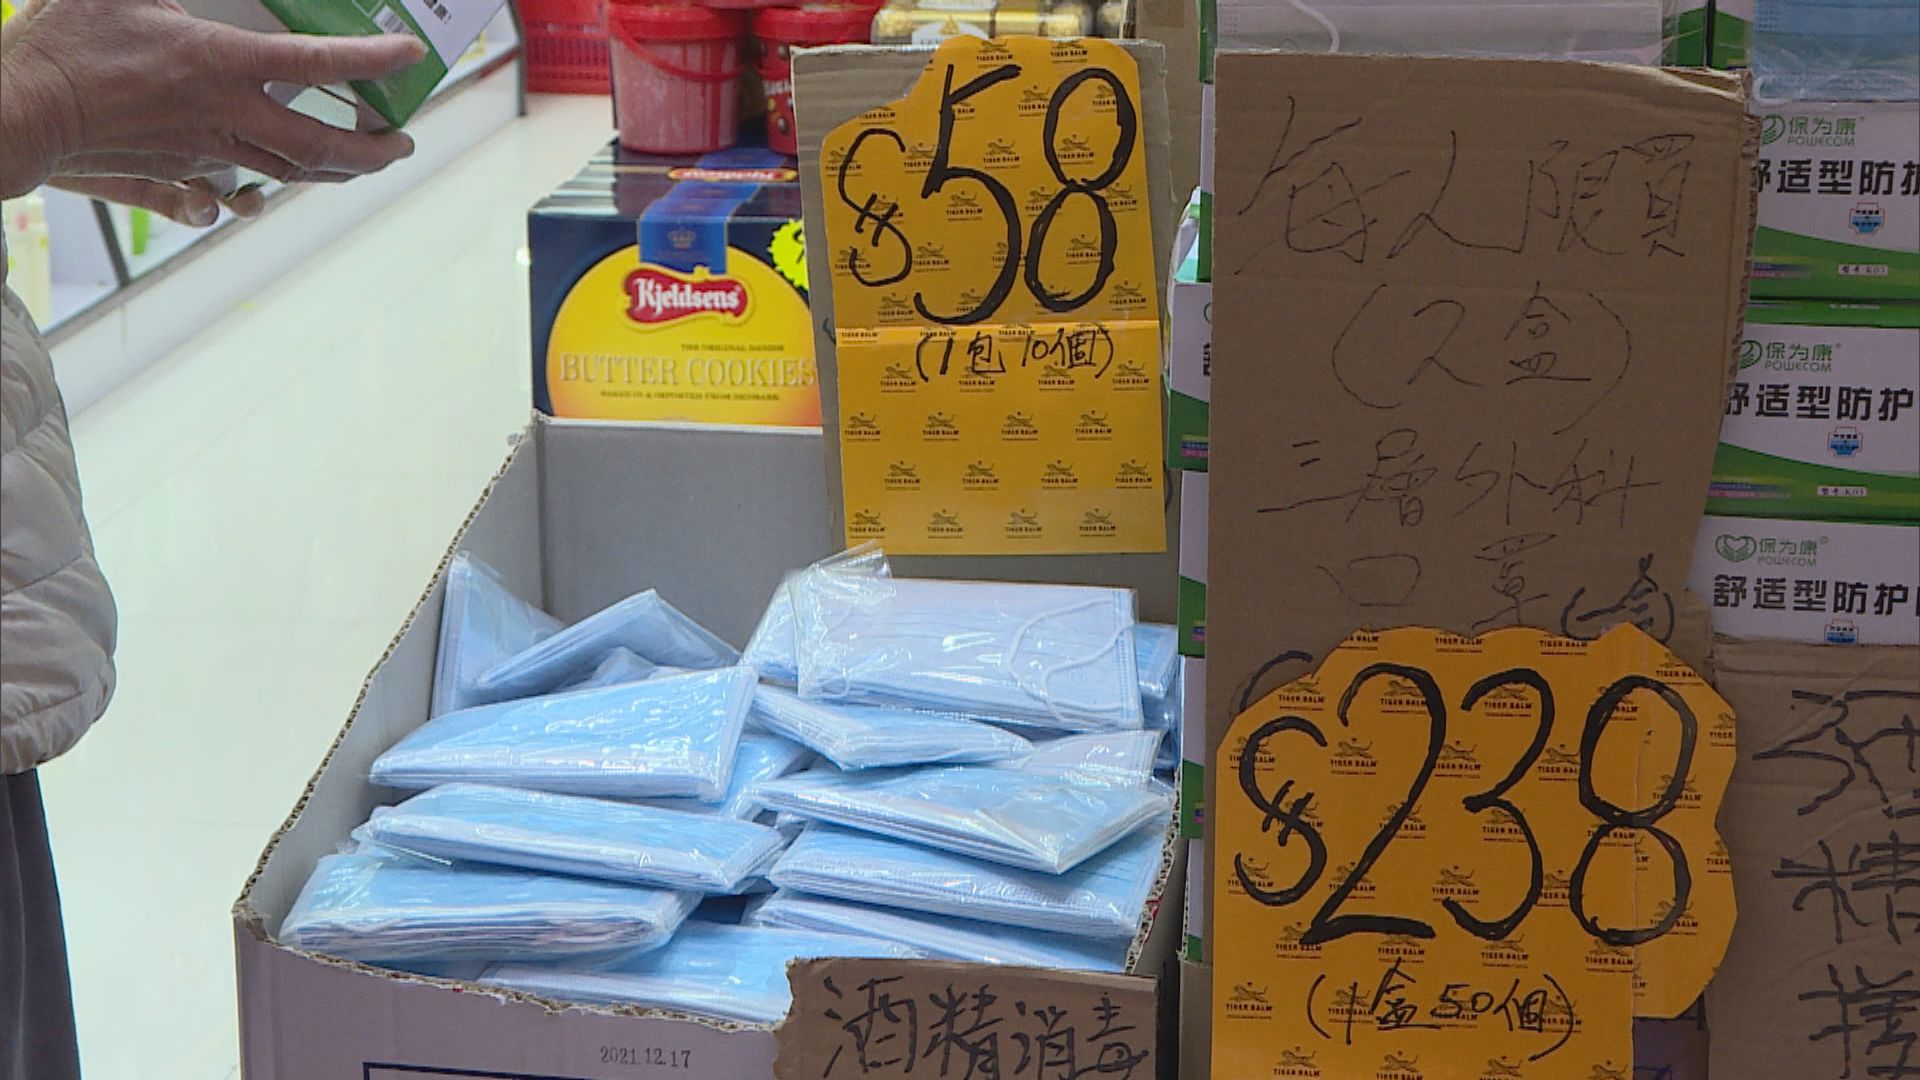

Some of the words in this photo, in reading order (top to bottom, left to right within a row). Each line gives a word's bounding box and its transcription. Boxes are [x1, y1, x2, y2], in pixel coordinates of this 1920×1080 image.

[976, 54, 994, 62] TIGER
[1050, 50, 1069, 58] TIGER
[1788, 115, 1857, 136] 保为康
[1058, 152, 1076, 160] TIGER
[904, 161, 922, 169] TIGER
[838, 64, 1137, 325] $58
[1026, 204, 1043, 212] TIGER
[631, 277, 741, 317] Kjeldsens
[1109, 298, 1127, 306] TIGER
[842, 331, 859, 339] TIGER
[860, 331, 878, 339] BALM
[998, 329, 1016, 337] TIGER
[1765, 342, 1833, 361] 保为康
[559, 352, 679, 385] BUTTER
[686, 356, 816, 388] COOKIES
[880, 380, 898, 388] TIGER
[898, 380, 916, 388] BALM
[958, 379, 976, 387] TIGER
[977, 379, 995, 387] BALM
[1112, 377, 1130, 385] TIGER
[1131, 377, 1149, 385] BALM
[844, 429, 862, 437] TIGER
[863, 429, 880, 437] BALM
[1000, 428, 1019, 436] TIGER
[1020, 428, 1038, 436] BALM
[1076, 427, 1093, 435] TIGER
[1094, 427, 1112, 435] BALM
[884, 477, 902, 485] TIGER
[903, 477, 920, 485] BALM
[962, 477, 980, 485] TIGER
[981, 477, 999, 485] BALM
[1040, 477, 1059, 485] TIGER
[1059, 477, 1078, 485] BALM
[1116, 476, 1134, 484] TIGER
[1134, 476, 1152, 484] BALM
[1758, 537, 1818, 555] 保为康
[1713, 574, 1920, 618] 舒适型防护
[1356, 636, 1379, 644] BALM
[1434, 636, 1458, 645] TIGER
[1539, 639, 1562, 648] TIGER
[1564, 641, 1588, 649] BALM
[1656, 669, 1678, 677] TIGER
[1278, 694, 1300, 703] TIGER
[1303, 696, 1324, 704] BALM
[1380, 697, 1403, 706] TIGER
[1484, 701, 1507, 709] TIGER
[1509, 702, 1532, 710] BALM
[1710, 731, 1732, 739] TIGER
[1330, 758, 1352, 767] TIGER
[1355, 760, 1377, 768] BALM
[1458, 764, 1480, 772] BALM
[1537, 765, 1559, 773] TIGER
[1562, 766, 1578, 774] BAL
[1234, 661, 1698, 947] $238
[1404, 824, 1426, 832] BALM
[1482, 825, 1505, 834] TIGER
[1611, 831, 1636, 839] BALM
[1432, 887, 1454, 895] TIGER
[1456, 888, 1479, 896] BALM
[1276, 943, 1297, 951] TIGER
[1378, 946, 1400, 955] TIGER
[1402, 948, 1424, 956] BALM
[1480, 951, 1503, 960] TIGER
[1506, 953, 1528, 961] BALM
[1585, 956, 1608, 965] TIGER
[1610, 958, 1634, 966] BALM
[1226, 1003, 1248, 1011] TIGER
[1250, 1004, 1272, 1012] BALM
[600, 1046, 691, 1069] 2021.12.17
[1274, 1068, 1296, 1076] TIGER
[1298, 1069, 1320, 1077] BALM
[1376, 1072, 1398, 1080] TIGER
